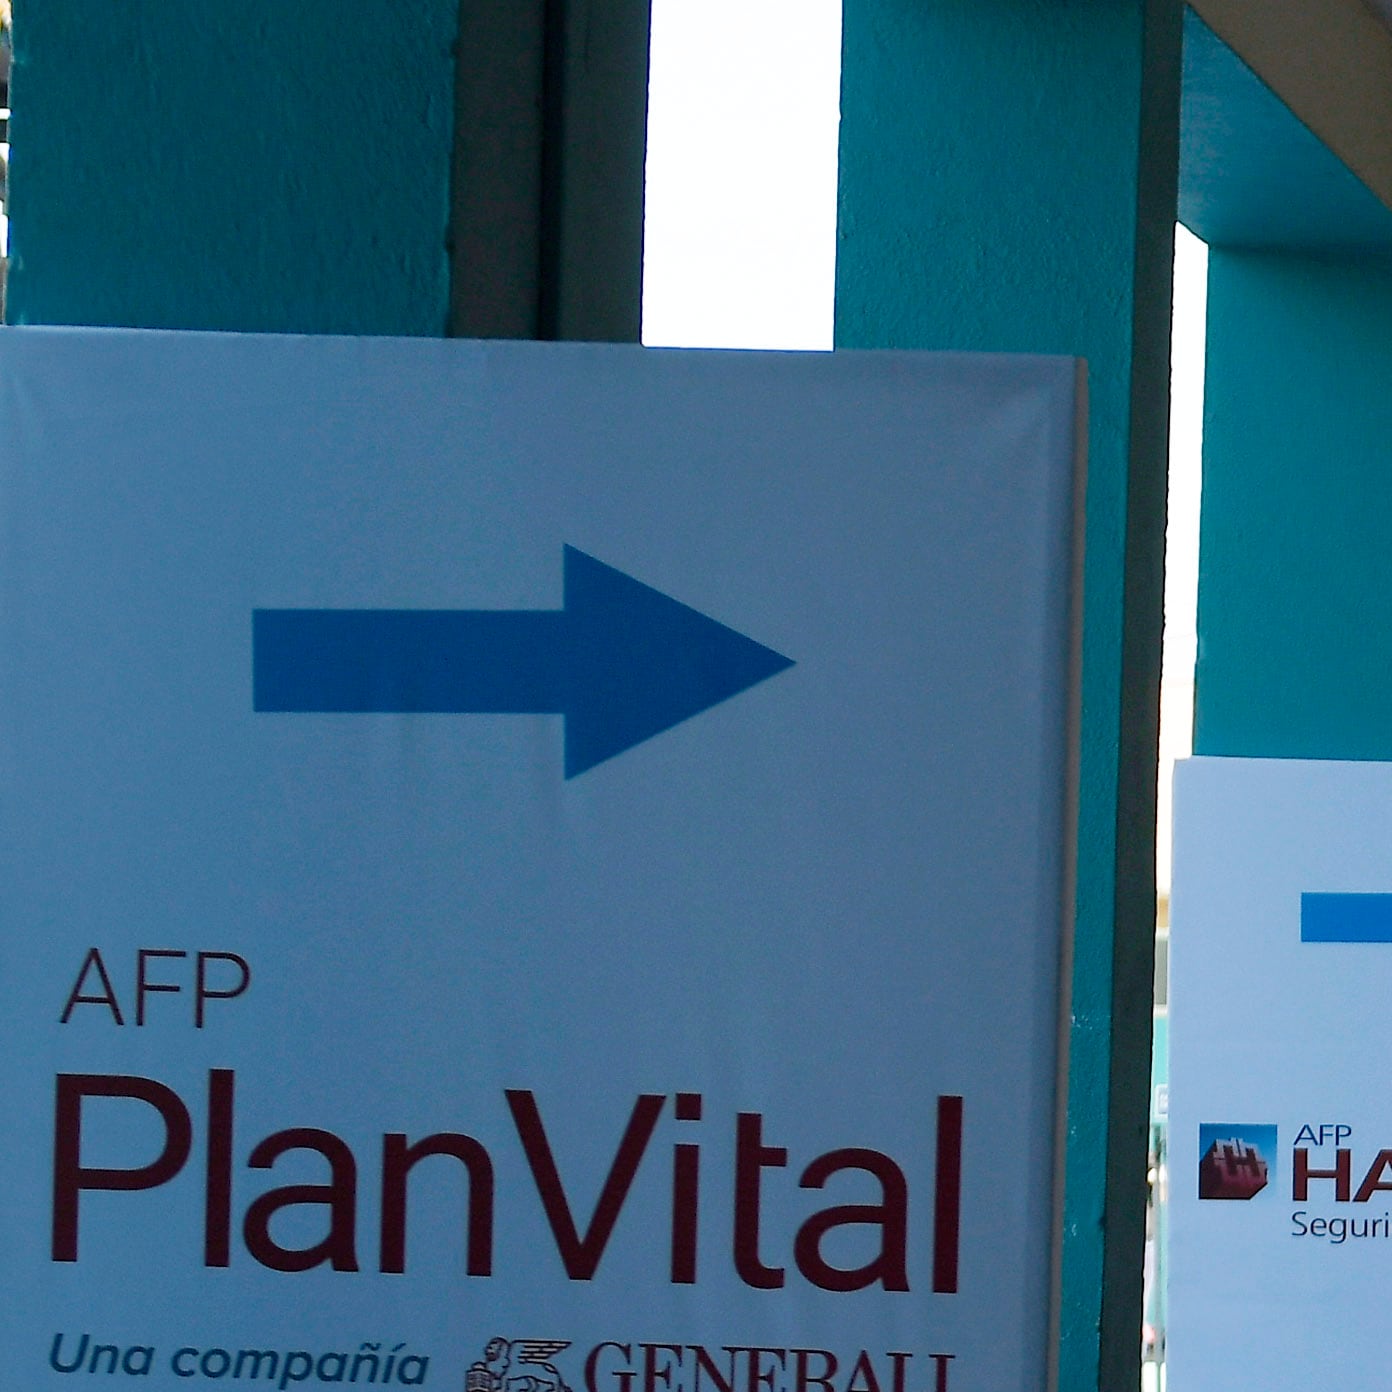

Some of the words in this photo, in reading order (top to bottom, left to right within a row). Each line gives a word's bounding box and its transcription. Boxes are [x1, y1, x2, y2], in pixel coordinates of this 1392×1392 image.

[60, 946, 251, 1029] AFP
[1293, 1123, 1352, 1147] AFP
[50, 1067, 963, 1294] PlanVital
[48, 1332, 154, 1378] Una
[170, 1339, 430, 1390] compañía
